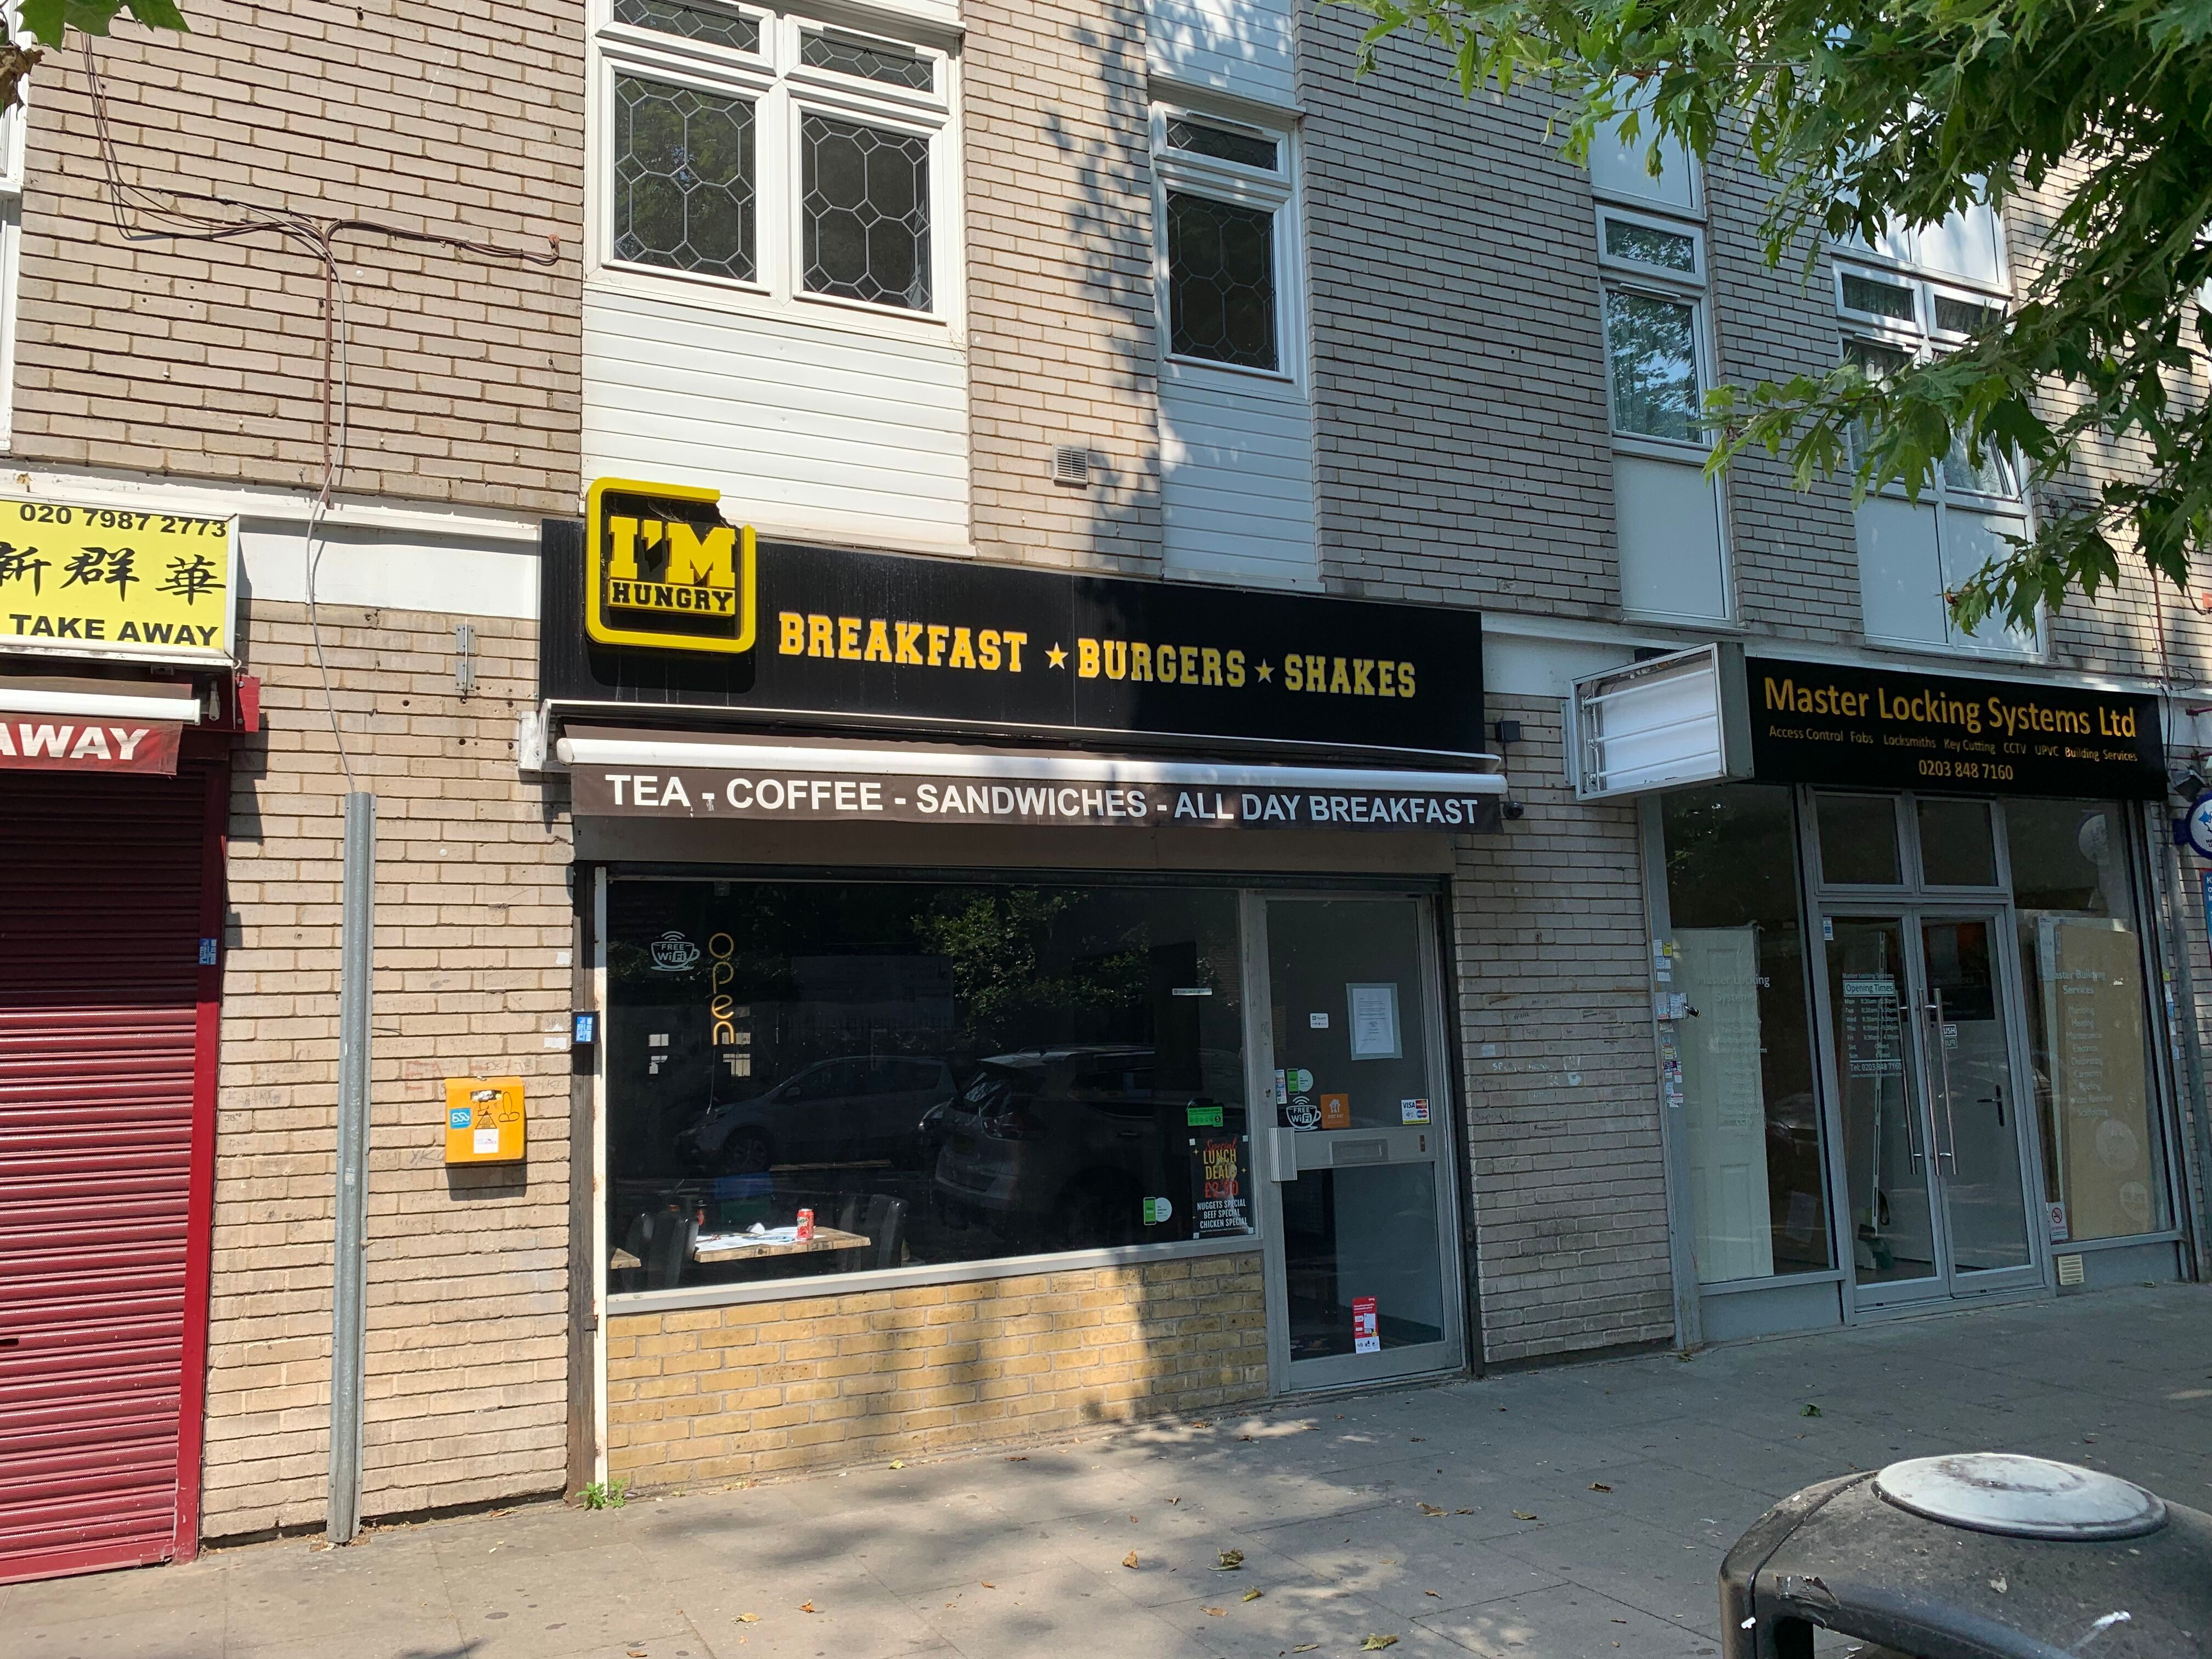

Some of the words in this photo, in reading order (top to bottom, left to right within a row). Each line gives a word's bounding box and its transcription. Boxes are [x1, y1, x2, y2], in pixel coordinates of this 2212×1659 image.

[20, 504, 72, 524] 020
[83, 508, 151, 532] 7987
[160, 515, 227, 538] 2773
[608, 516, 736, 588] I'M
[612, 582, 735, 613] HUNGRY
[9, 613, 105, 640] TAKE
[118, 620, 219, 646] AWAY
[778, 611, 1028, 673] BREAKFAST
[1077, 637, 1246, 688] BURGERS
[1284, 653, 1417, 698] SHAKES
[1764, 676, 1870, 717] Master
[1878, 687, 1982, 734] Locking
[1988, 696, 2091, 736] Systems
[2099, 706, 2137, 738] Ltd
[1769, 725, 1804, 738] Access
[1806, 728, 1844, 742] Control
[1850, 731, 1874, 744] Fobs
[1883, 734, 1937, 748] Locksmiths
[1944, 738, 1961, 753] Key
[1962, 740, 1996, 755] Cutting
[2003, 742, 2027, 755] CCTV
[2034, 744, 2059, 757] UPVC
[2064, 747, 2100, 762] Building
[2103, 749, 2138, 761] Services
[1918, 759, 1951, 777] 0203
[1954, 761, 1979, 778] 848
[1982, 763, 2014, 780] 7160
[605, 774, 691, 808] TEA
[726, 777, 883, 811] COFFEE
[916, 784, 1147, 819] SANDWICHES
[1174, 791, 1234, 820] ALL
[1243, 794, 1301, 821] DAY
[1311, 795, 1478, 825] BREAKFAST
[657, 951, 686, 962] WiFi
[2054, 971, 2073, 980] aster
[2075, 969, 2107, 981] Building
[1846, 984, 1874, 994] Opening
[1874, 984, 1894, 992] Times
[2063, 985, 2095, 995] Services
[1290, 1114, 1312, 1123] WiFi
[1206, 1137, 1237, 1152] Special
[1203, 1148, 1237, 1164] LUNCH
[1197, 1200, 1223, 1211] NUGGETS
[1224, 1199, 1246, 1209] SPECIAL
[1204, 1210, 1217, 1219] BEEF
[1218, 1209, 1241, 1218] SPECIAL
[1200, 1219, 1224, 1229] CHICKEN
[1225, 1217, 1248, 1227] SPECIAL
